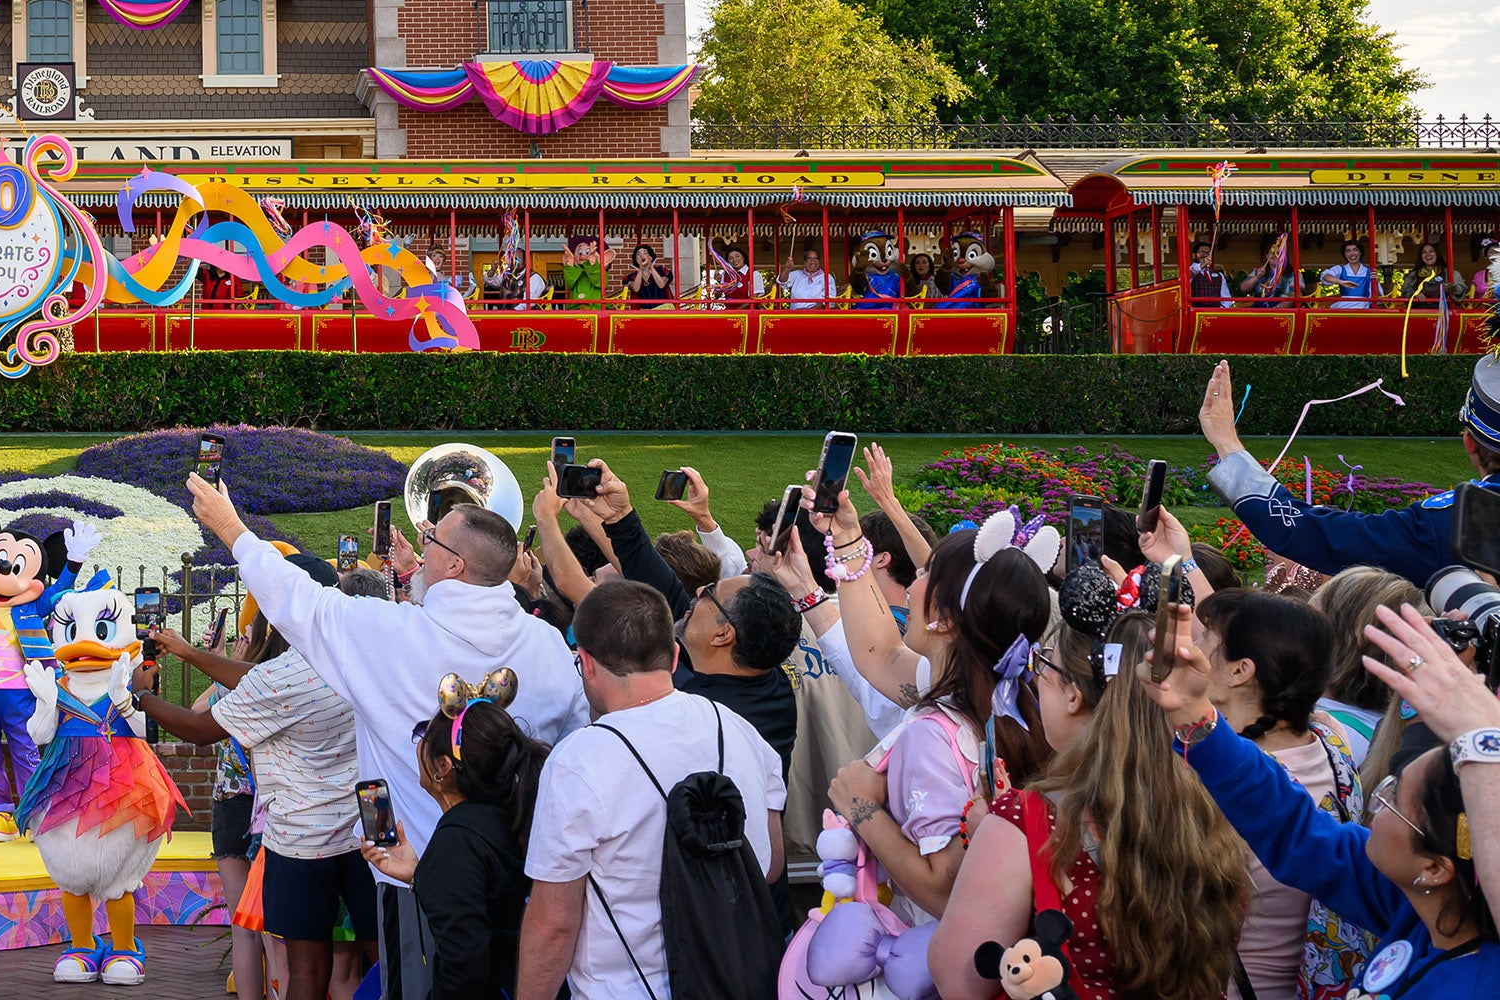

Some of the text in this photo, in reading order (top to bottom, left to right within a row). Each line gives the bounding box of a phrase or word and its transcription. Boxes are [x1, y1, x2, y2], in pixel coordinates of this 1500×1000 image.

[23, 70, 70, 91] Disneyland
[26, 96, 66, 114] RAILROAD
[211, 145, 281, 156] ELEVATION
[208, 175, 850, 185] DISNEYLAND RAILROAD
